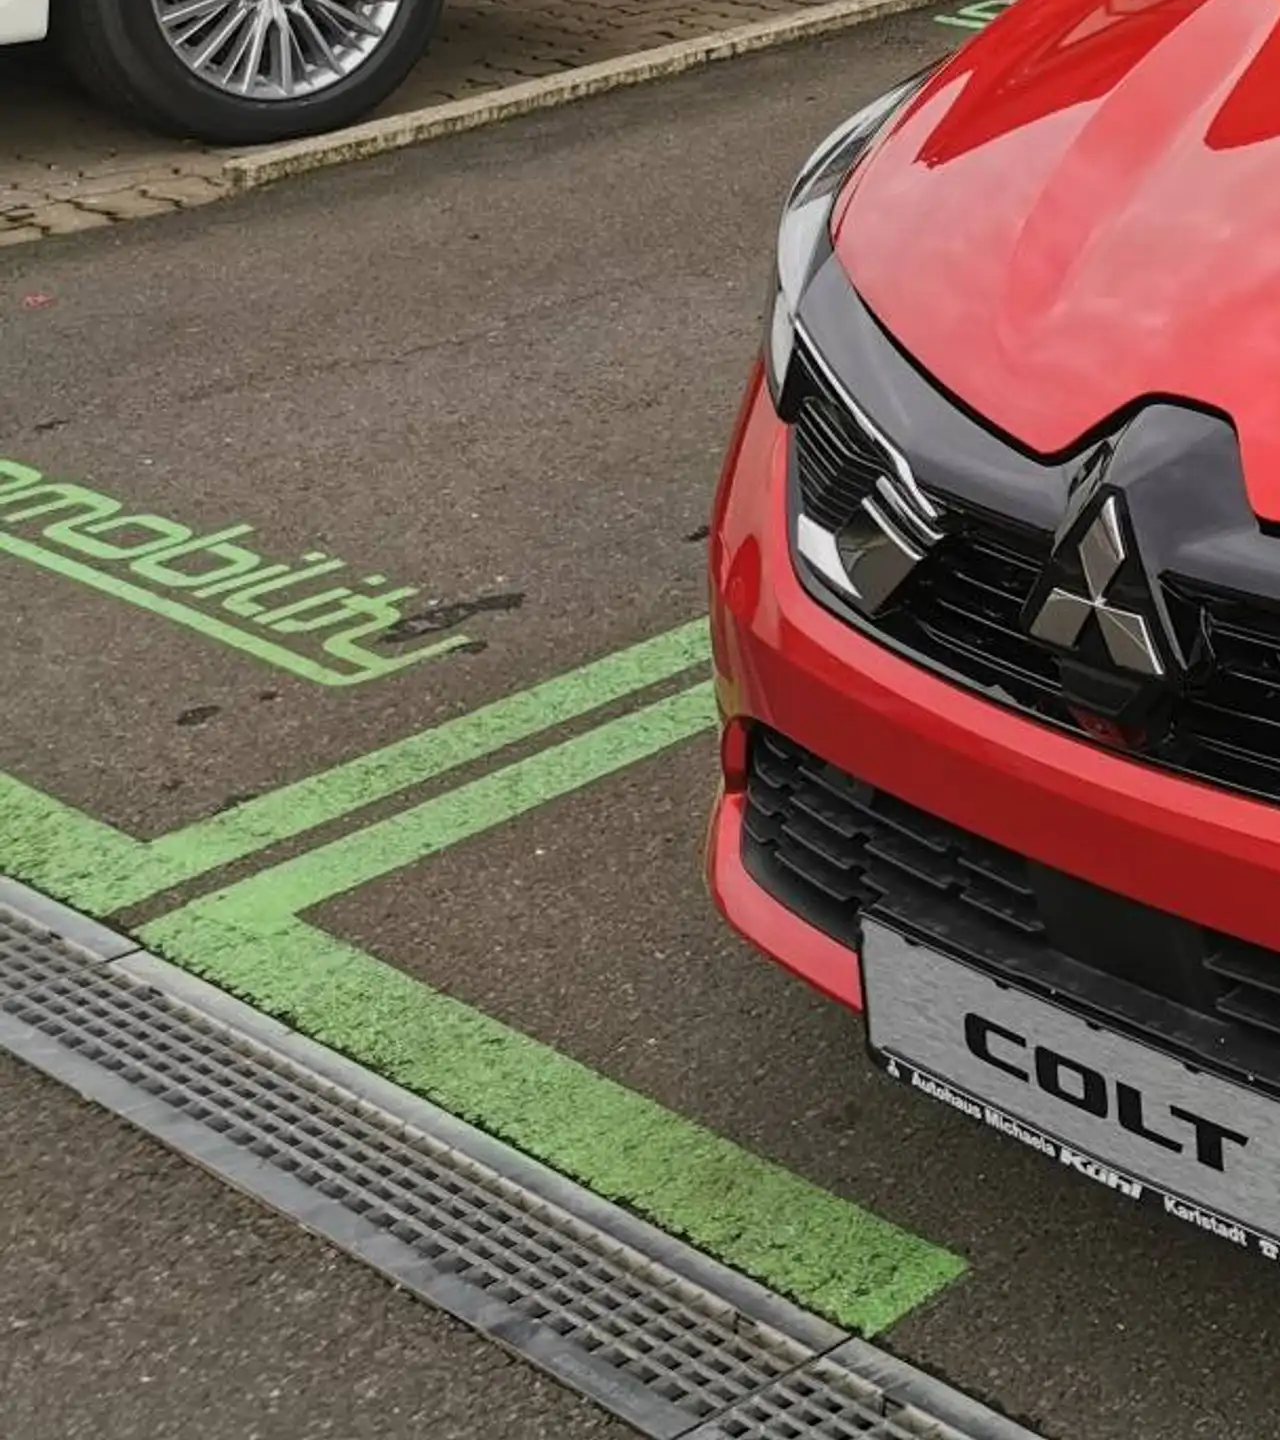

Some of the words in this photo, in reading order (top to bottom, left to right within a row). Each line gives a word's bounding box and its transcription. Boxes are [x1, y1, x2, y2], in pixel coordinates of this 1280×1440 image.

[911, 1070, 982, 1120] Autohaus
[984, 1107, 1056, 1158] Michaela
[1059, 1146, 1144, 1200] Kühl
[1163, 1194, 1248, 1247] Karlstadt
[964, 1011, 1249, 1172] COLT
